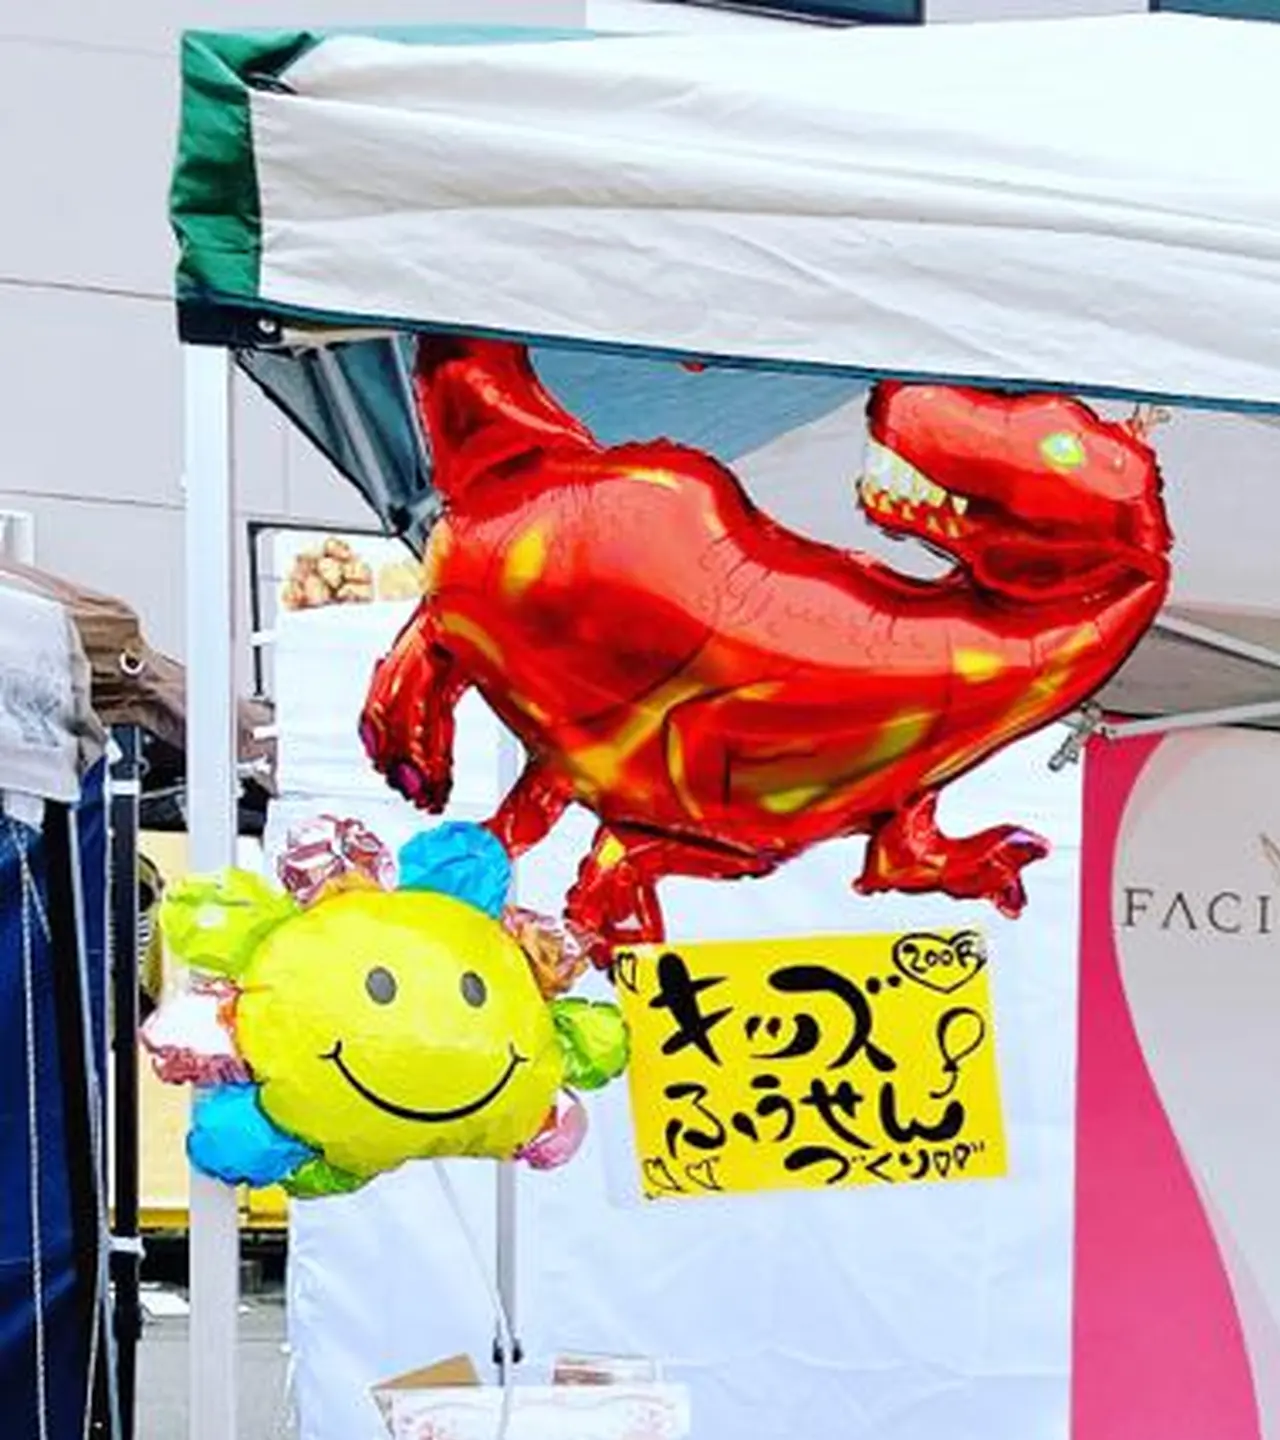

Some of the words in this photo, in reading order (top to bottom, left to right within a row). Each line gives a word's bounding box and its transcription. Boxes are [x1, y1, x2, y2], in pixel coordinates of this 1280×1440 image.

[650, 952, 901, 1072] キッズ
[664, 1074, 965, 1158] ふうせん
